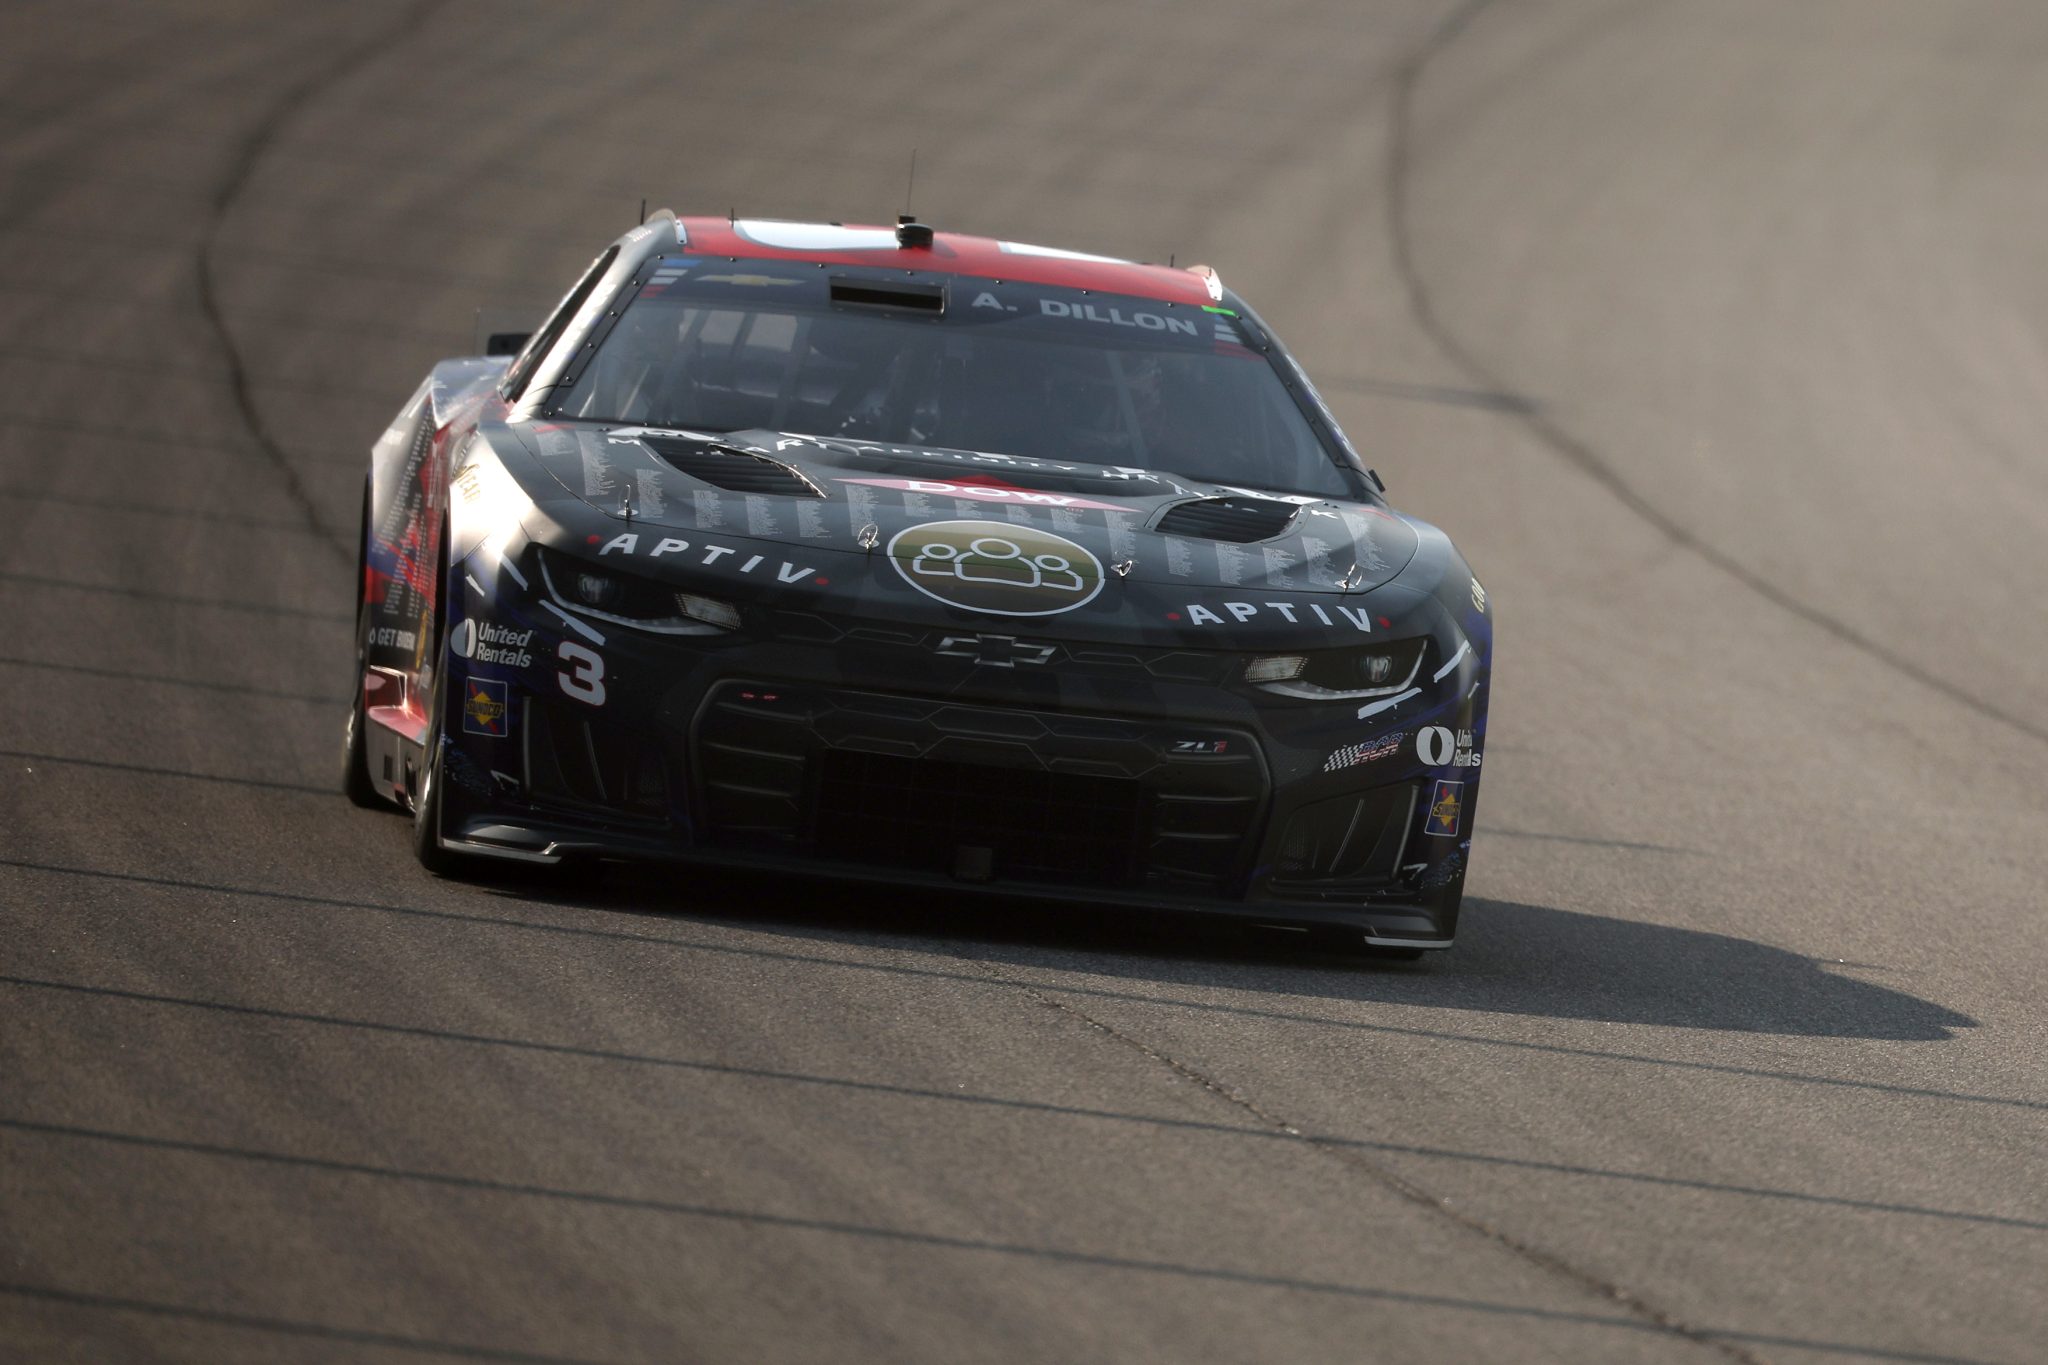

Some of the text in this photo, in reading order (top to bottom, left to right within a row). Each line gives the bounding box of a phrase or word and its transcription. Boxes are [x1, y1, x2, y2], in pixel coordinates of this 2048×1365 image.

[972, 292, 1198, 336] A. DILLON
[599, 533, 816, 584] APTIV
[478, 622, 533, 648] United
[1186, 602, 1371, 633] APTIV
[476, 642, 533, 668] Rentals
[558, 640, 606, 707] 3
